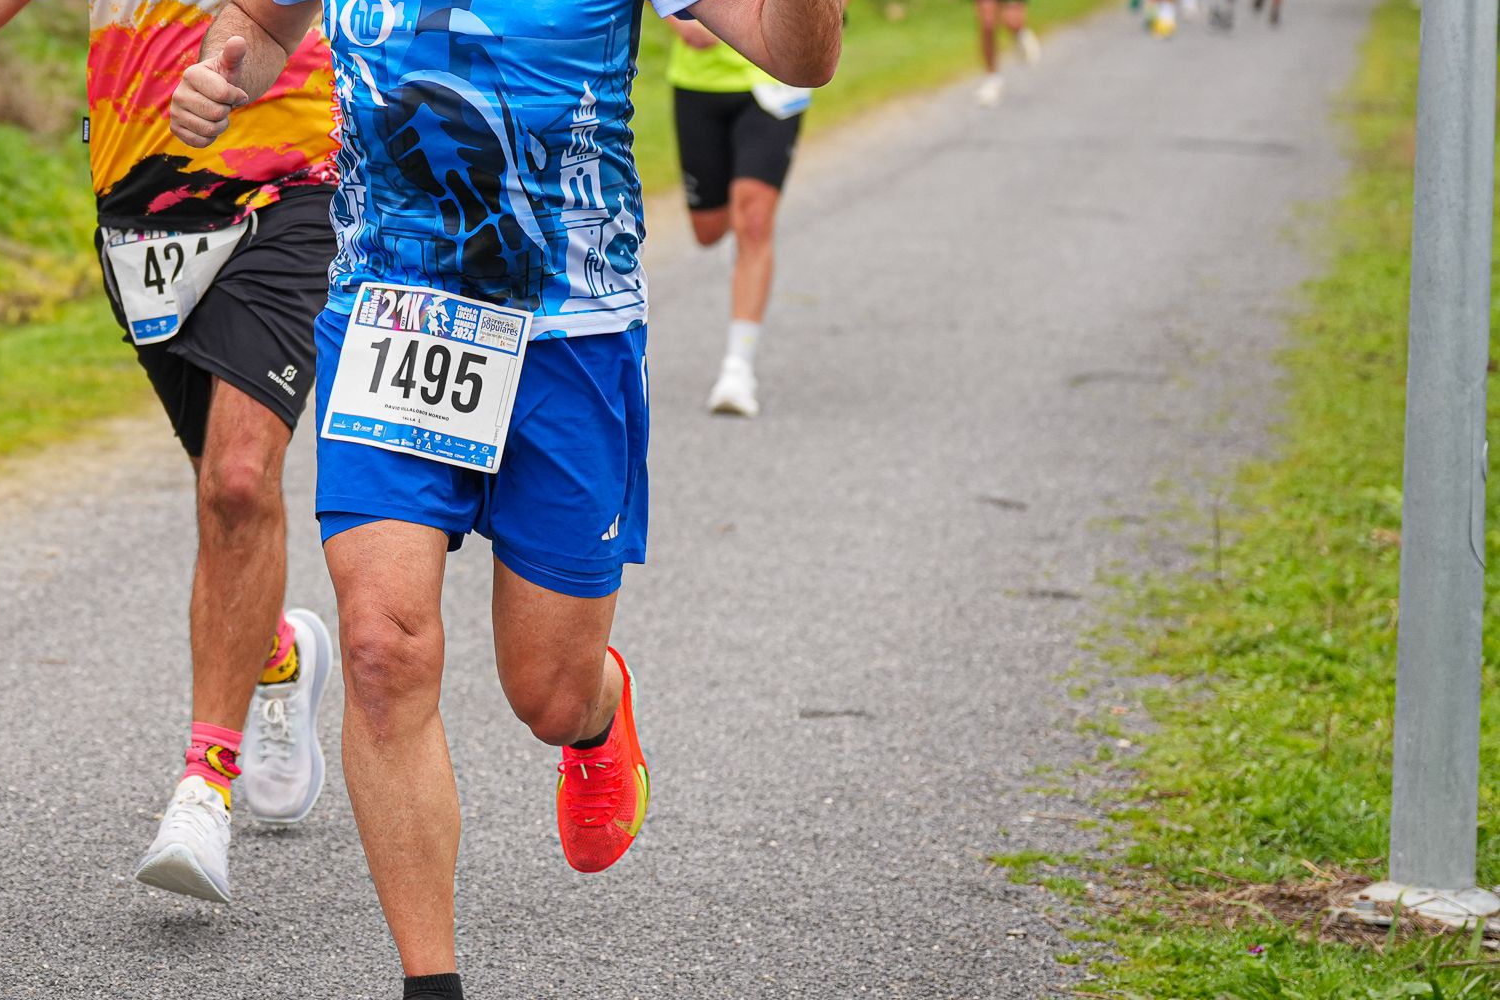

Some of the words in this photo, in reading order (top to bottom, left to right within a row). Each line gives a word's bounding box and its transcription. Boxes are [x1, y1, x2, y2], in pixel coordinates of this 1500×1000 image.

[144, 237, 209, 295] 42
[377, 290, 426, 331] 21K
[480, 322, 519, 337] populares
[451, 326, 474, 342] 2026
[368, 337, 488, 414] 1495
